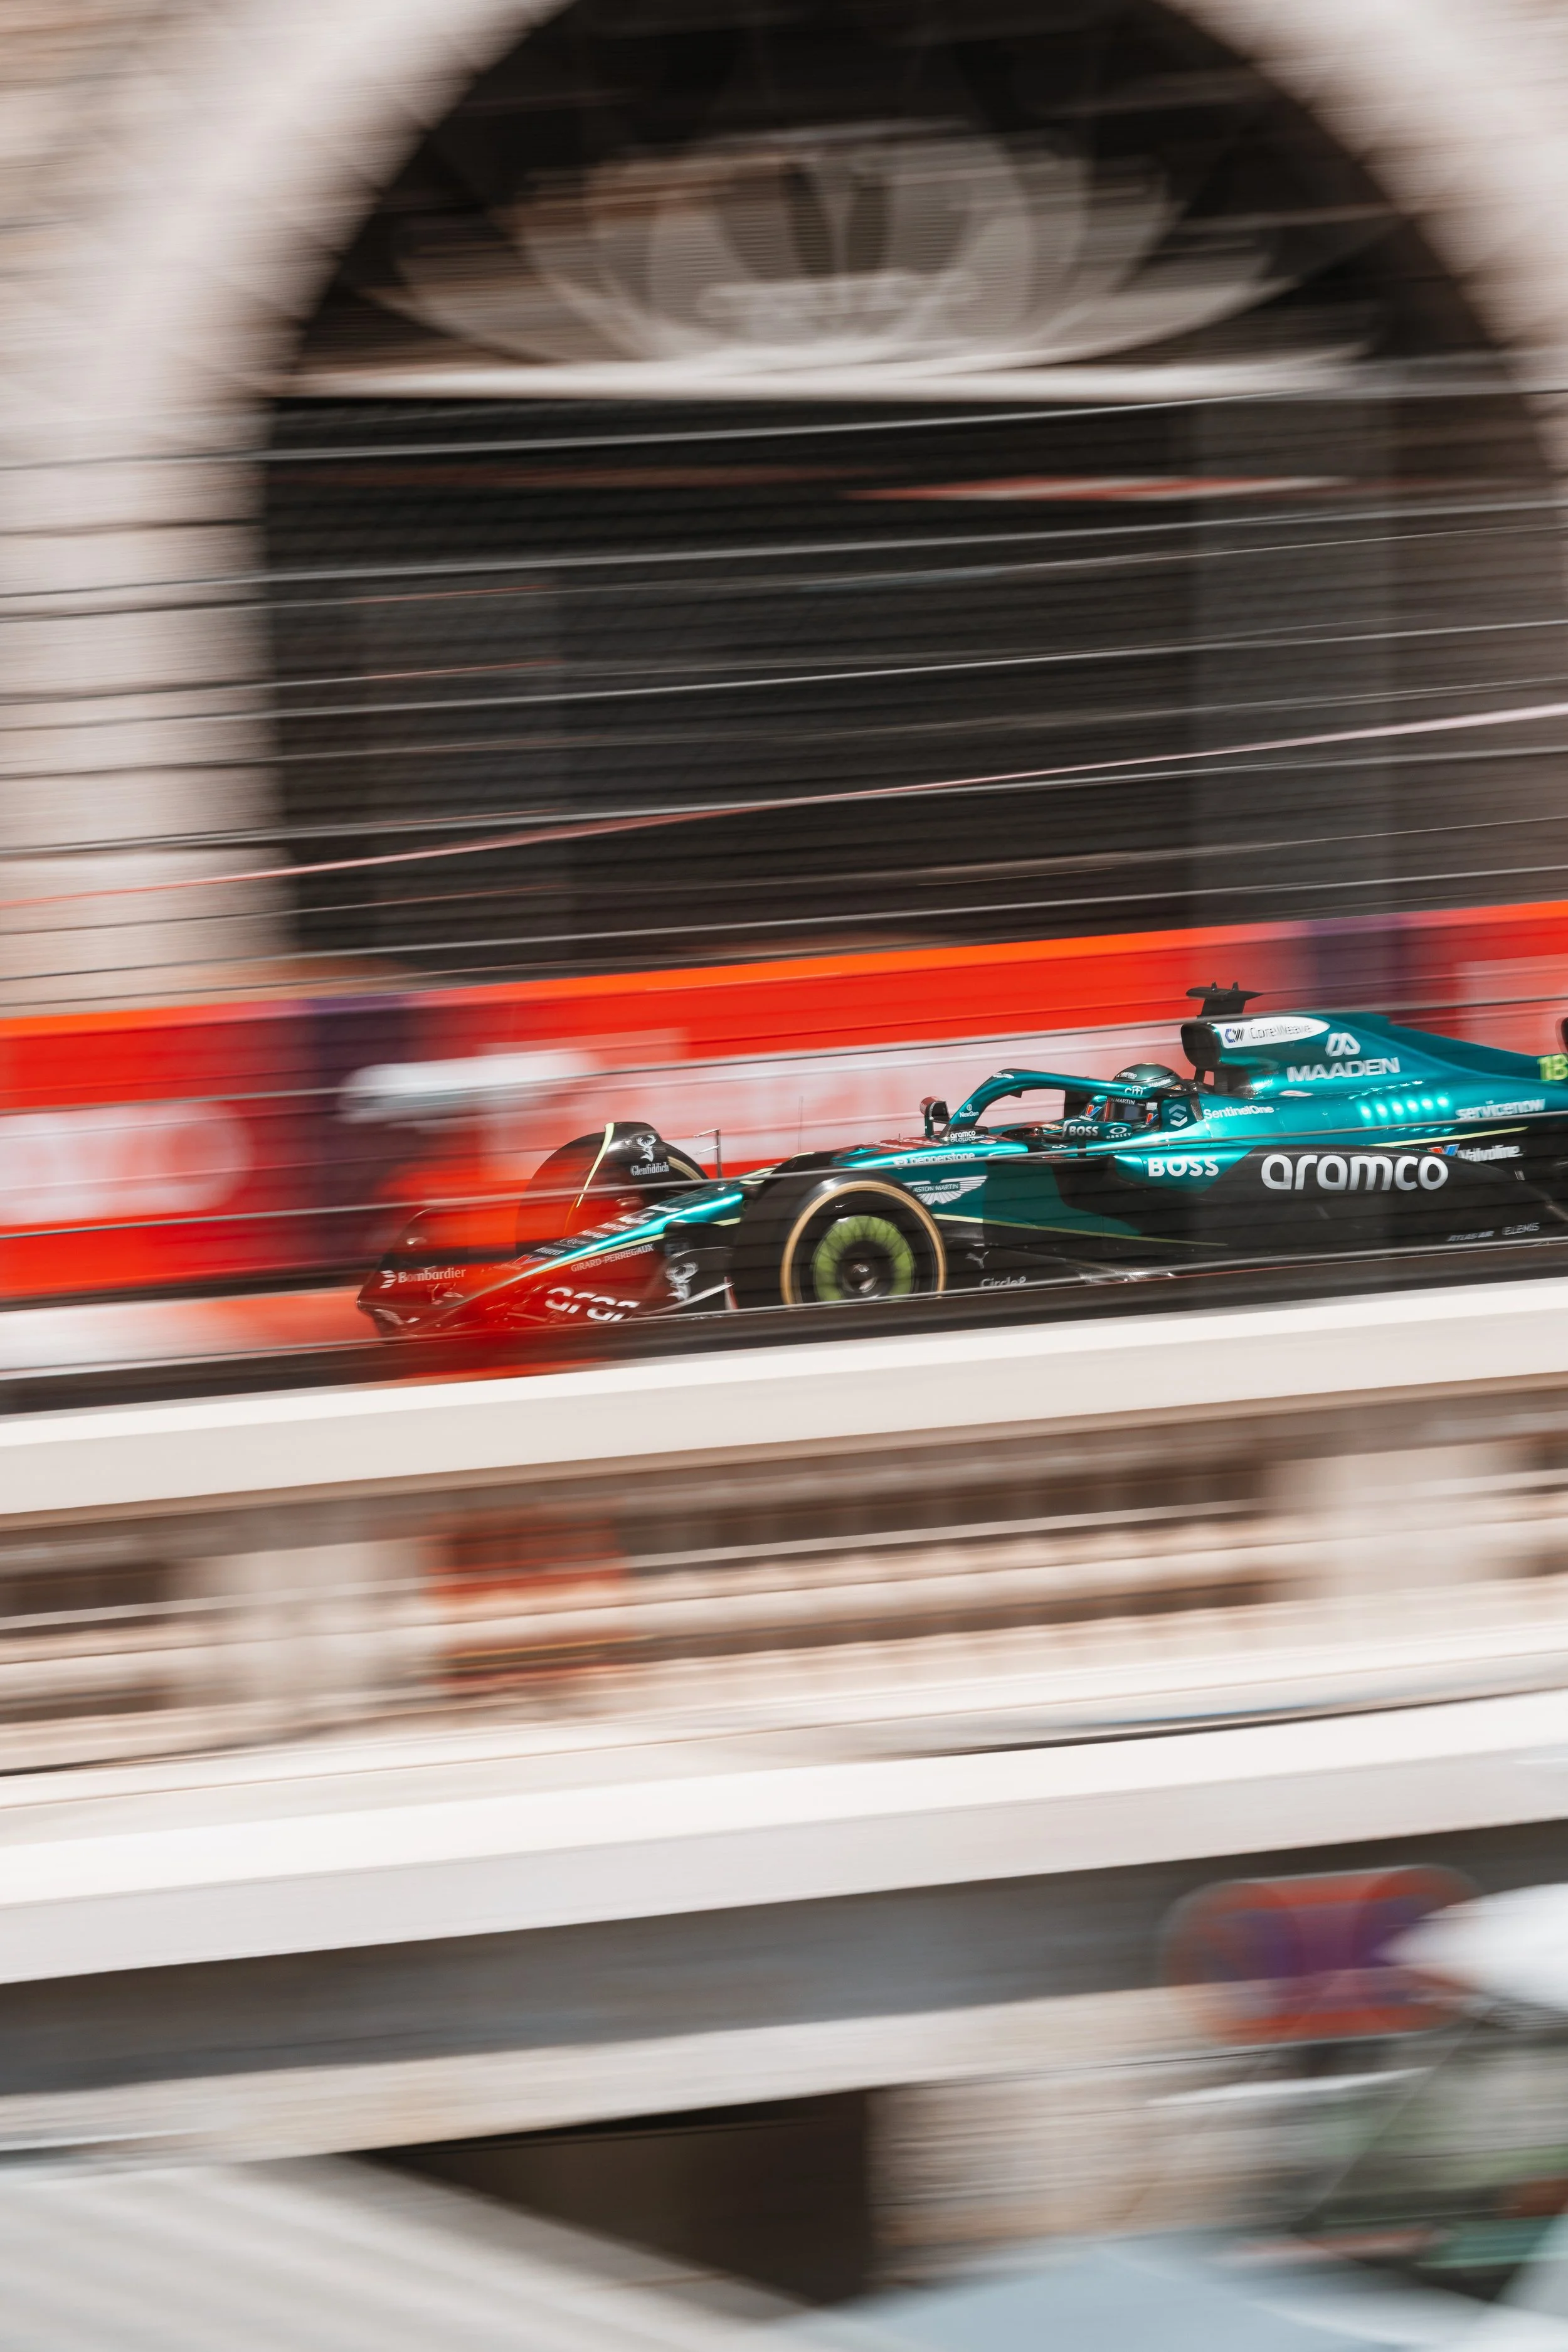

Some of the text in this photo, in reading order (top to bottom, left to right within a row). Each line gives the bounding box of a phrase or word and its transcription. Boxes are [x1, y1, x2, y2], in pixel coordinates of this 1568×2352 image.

[1249, 1025, 1313, 1039] CoreWeave
[1287, 1057, 1401, 1083] MAADEN
[1125, 1086, 1143, 1097] citi
[1203, 1105, 1274, 1120] SentinelOne
[1455, 1100, 1545, 1120] servicenow
[950, 1130, 976, 1138] aramco
[1069, 1126, 1099, 1136] BOSS
[908, 1152, 975, 1165] pepperstone
[630, 1162, 669, 1176] Glenfiddich
[1148, 1157, 1219, 1177] BOSS
[1261, 1154, 1448, 1190] aramco
[935, 1183, 959, 1191] MARTIN
[571, 1243, 654, 1272] GIRARD-PERREGAUX
[398, 1267, 466, 1283] Bombardier
